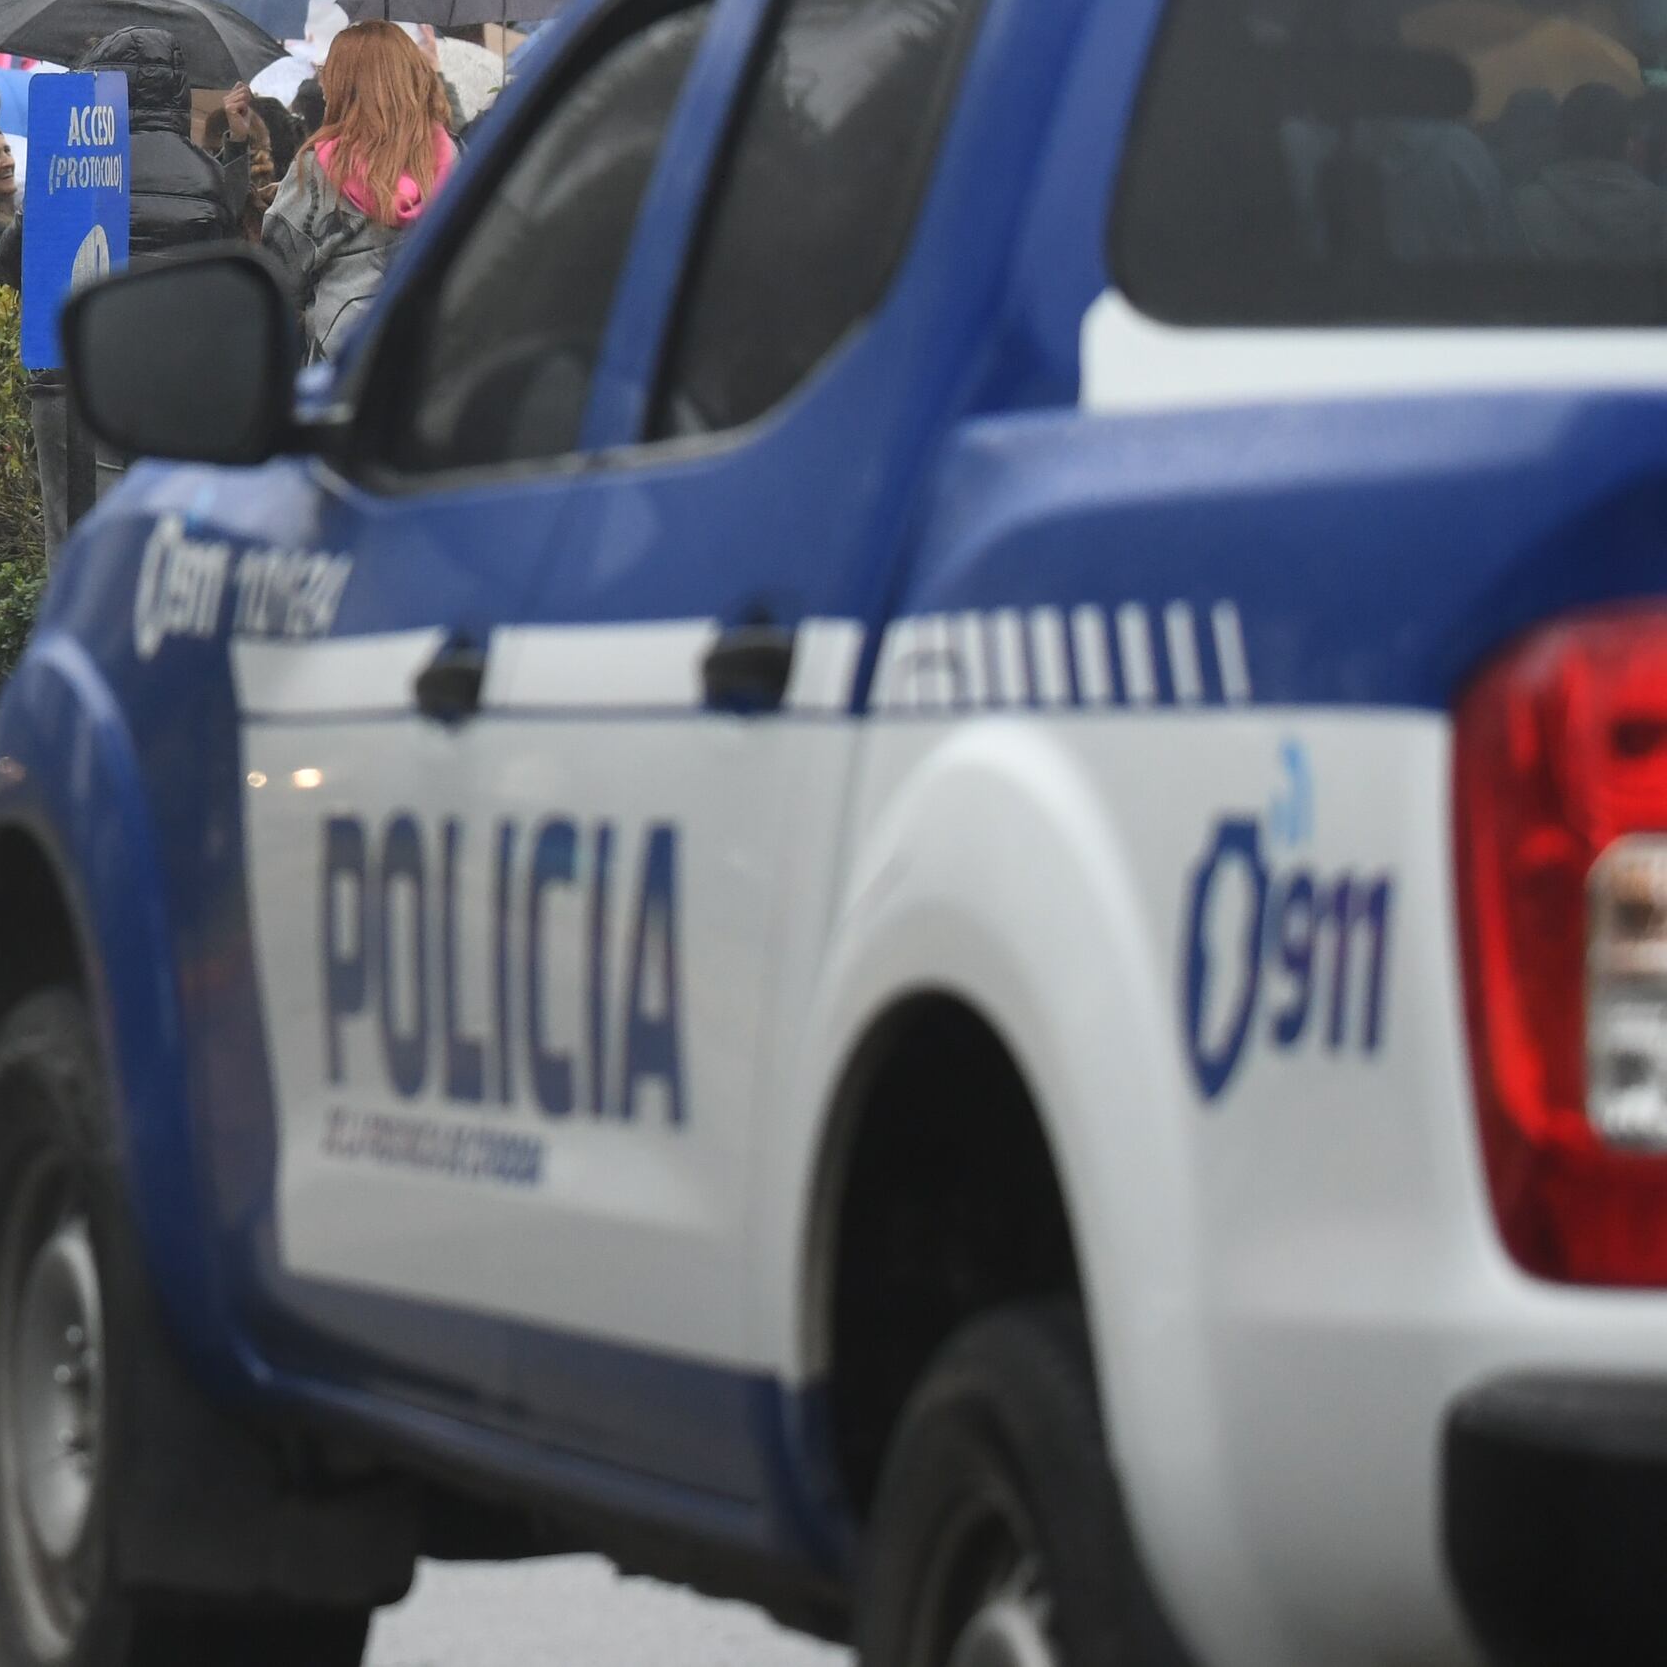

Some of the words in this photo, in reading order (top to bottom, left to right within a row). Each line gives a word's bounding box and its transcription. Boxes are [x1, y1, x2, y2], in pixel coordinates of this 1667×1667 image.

[67, 105, 115, 146] ACCESO
[48, 154, 122, 195] (PROTOCOLO)
[317, 811, 689, 1129] POLICIA
